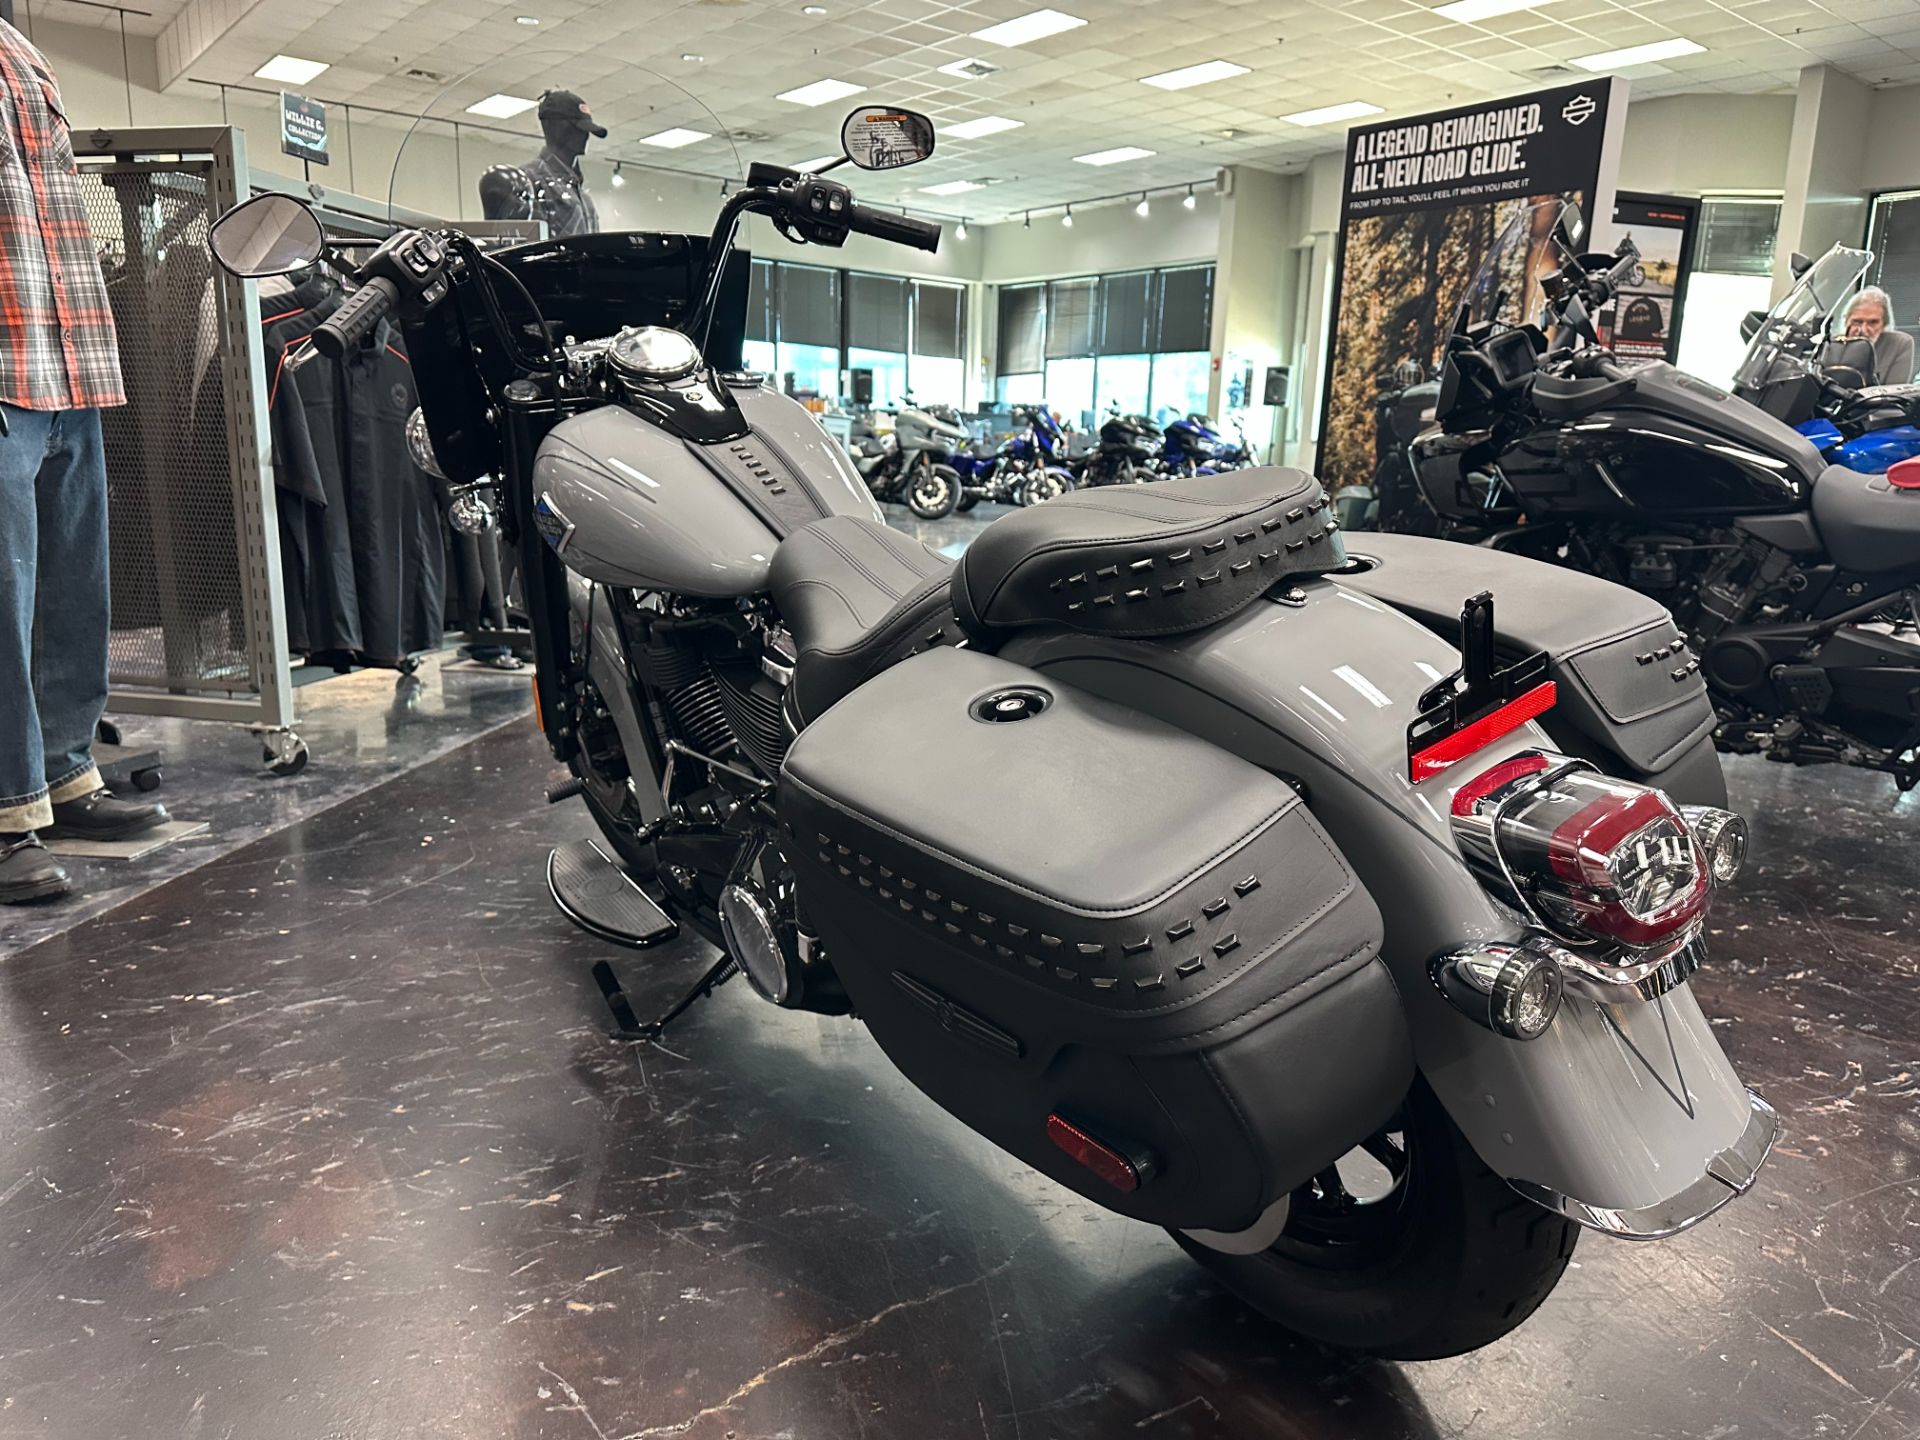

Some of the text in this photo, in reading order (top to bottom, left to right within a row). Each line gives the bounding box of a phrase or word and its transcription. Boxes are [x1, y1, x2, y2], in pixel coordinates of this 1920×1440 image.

[285, 109, 315, 128] WILLIE
[287, 123, 322, 140] COLLECTION
[1354, 103, 1544, 163] A LEGEND REIMAGINED.
[1351, 157, 1422, 194] ALL-NEW
[1421, 149, 1468, 183] ROAD
[1349, 200, 1370, 210] FROM
[1370, 198, 1381, 207] TIP
[1382, 197, 1391, 206] TO
[1408, 192, 1432, 202] YOU'LL
[1433, 189, 1452, 199] FEEL
[1452, 188, 1459, 197] IT
[1459, 185, 1483, 196] WHEN
[1484, 182, 1501, 192] YOU
[1501, 179, 1521, 190] RIDE
[1521, 177, 1530, 187] IT
